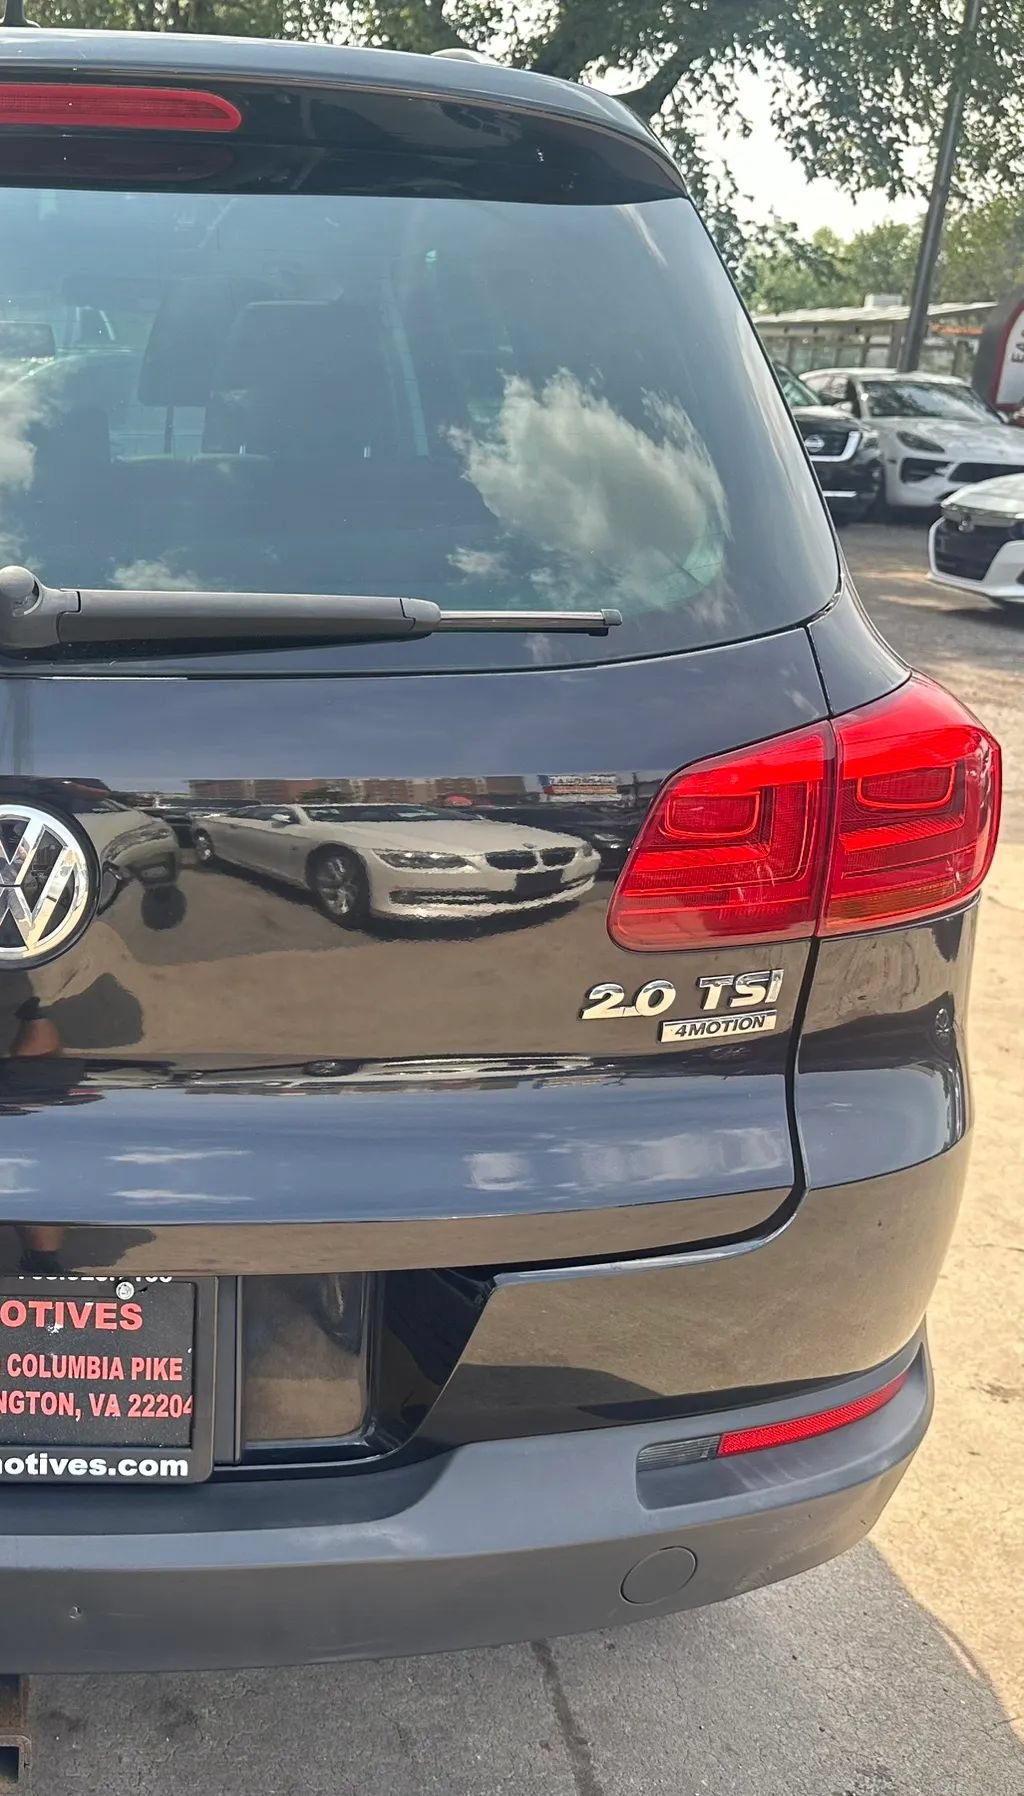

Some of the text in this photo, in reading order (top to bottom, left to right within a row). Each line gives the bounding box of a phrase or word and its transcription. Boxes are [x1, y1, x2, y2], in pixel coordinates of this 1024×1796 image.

[580, 968, 784, 1020] 2.0 TSI
[675, 1015, 766, 1038] 4MOTION
[7, 1354, 125, 1381] COLUMBIA
[130, 1357, 184, 1381] PIKE
[89, 1394, 121, 1417] VA
[127, 1395, 193, 1419] 22204
